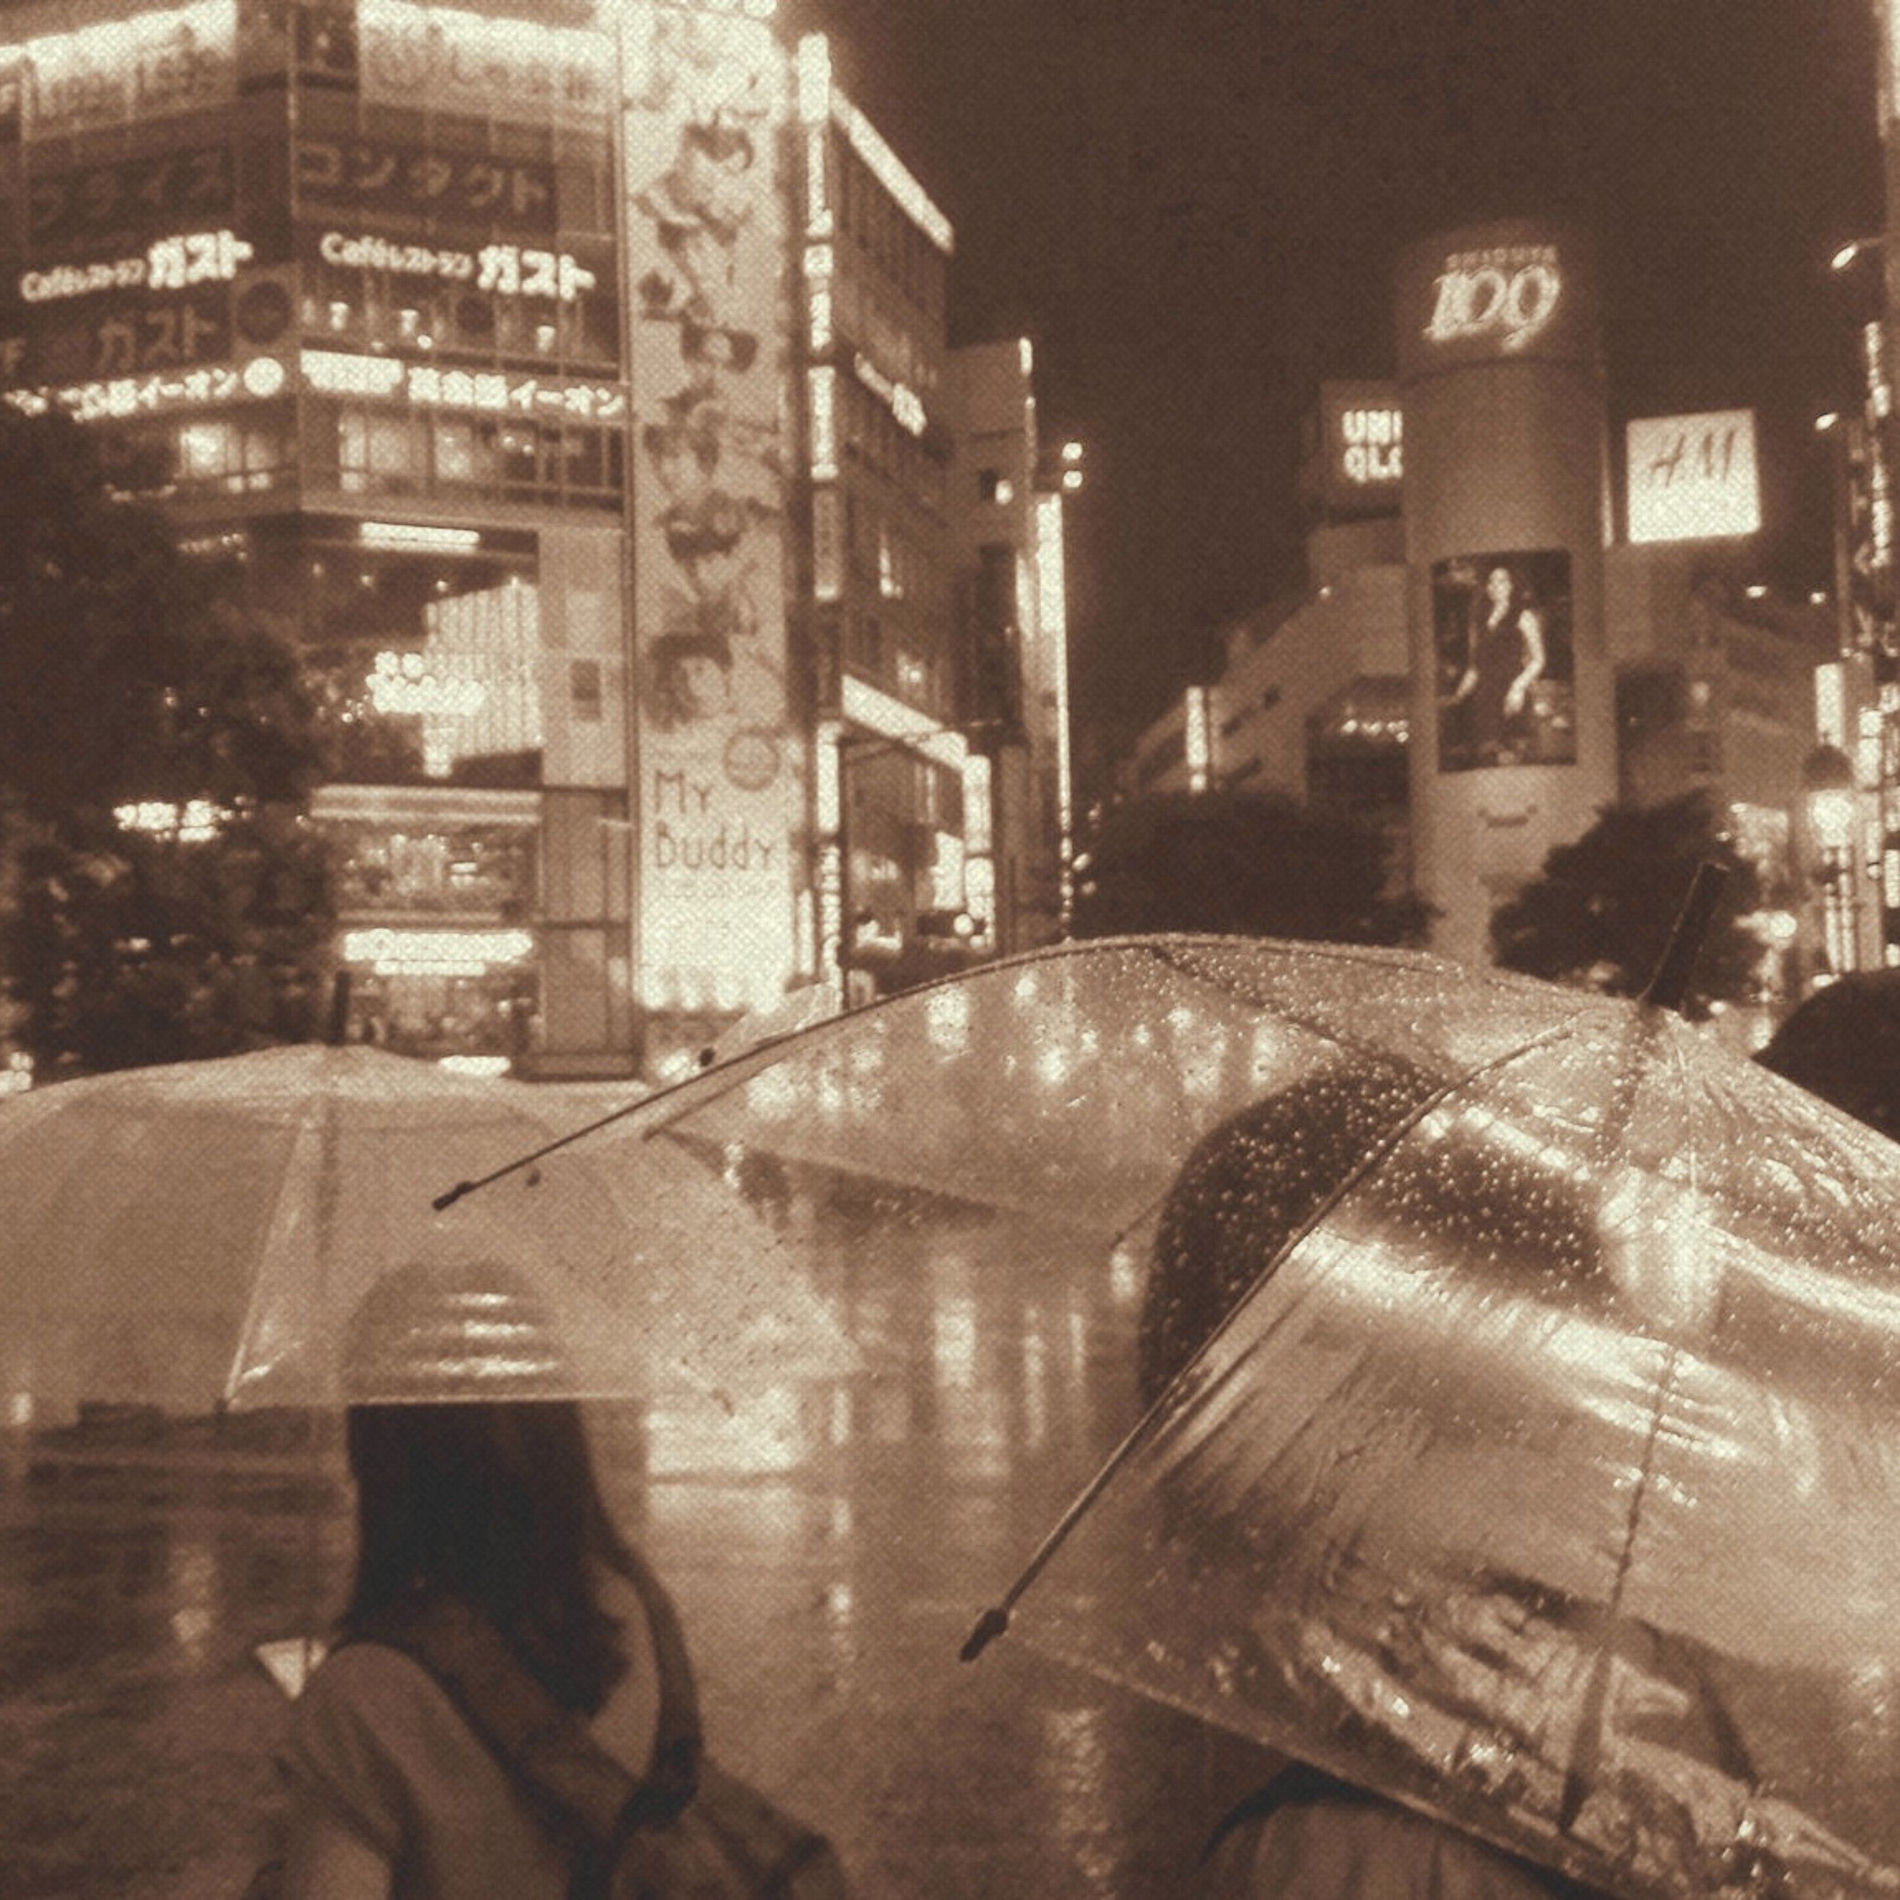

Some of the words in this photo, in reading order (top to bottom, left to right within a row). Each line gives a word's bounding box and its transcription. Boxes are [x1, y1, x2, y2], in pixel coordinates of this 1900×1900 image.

[149, 229, 254, 290] ガスト
[477, 243, 597, 300] ガスト
[97, 304, 217, 373] ガスト
[1422, 264, 1561, 352] 109
[1341, 409, 1403, 446] UNI
